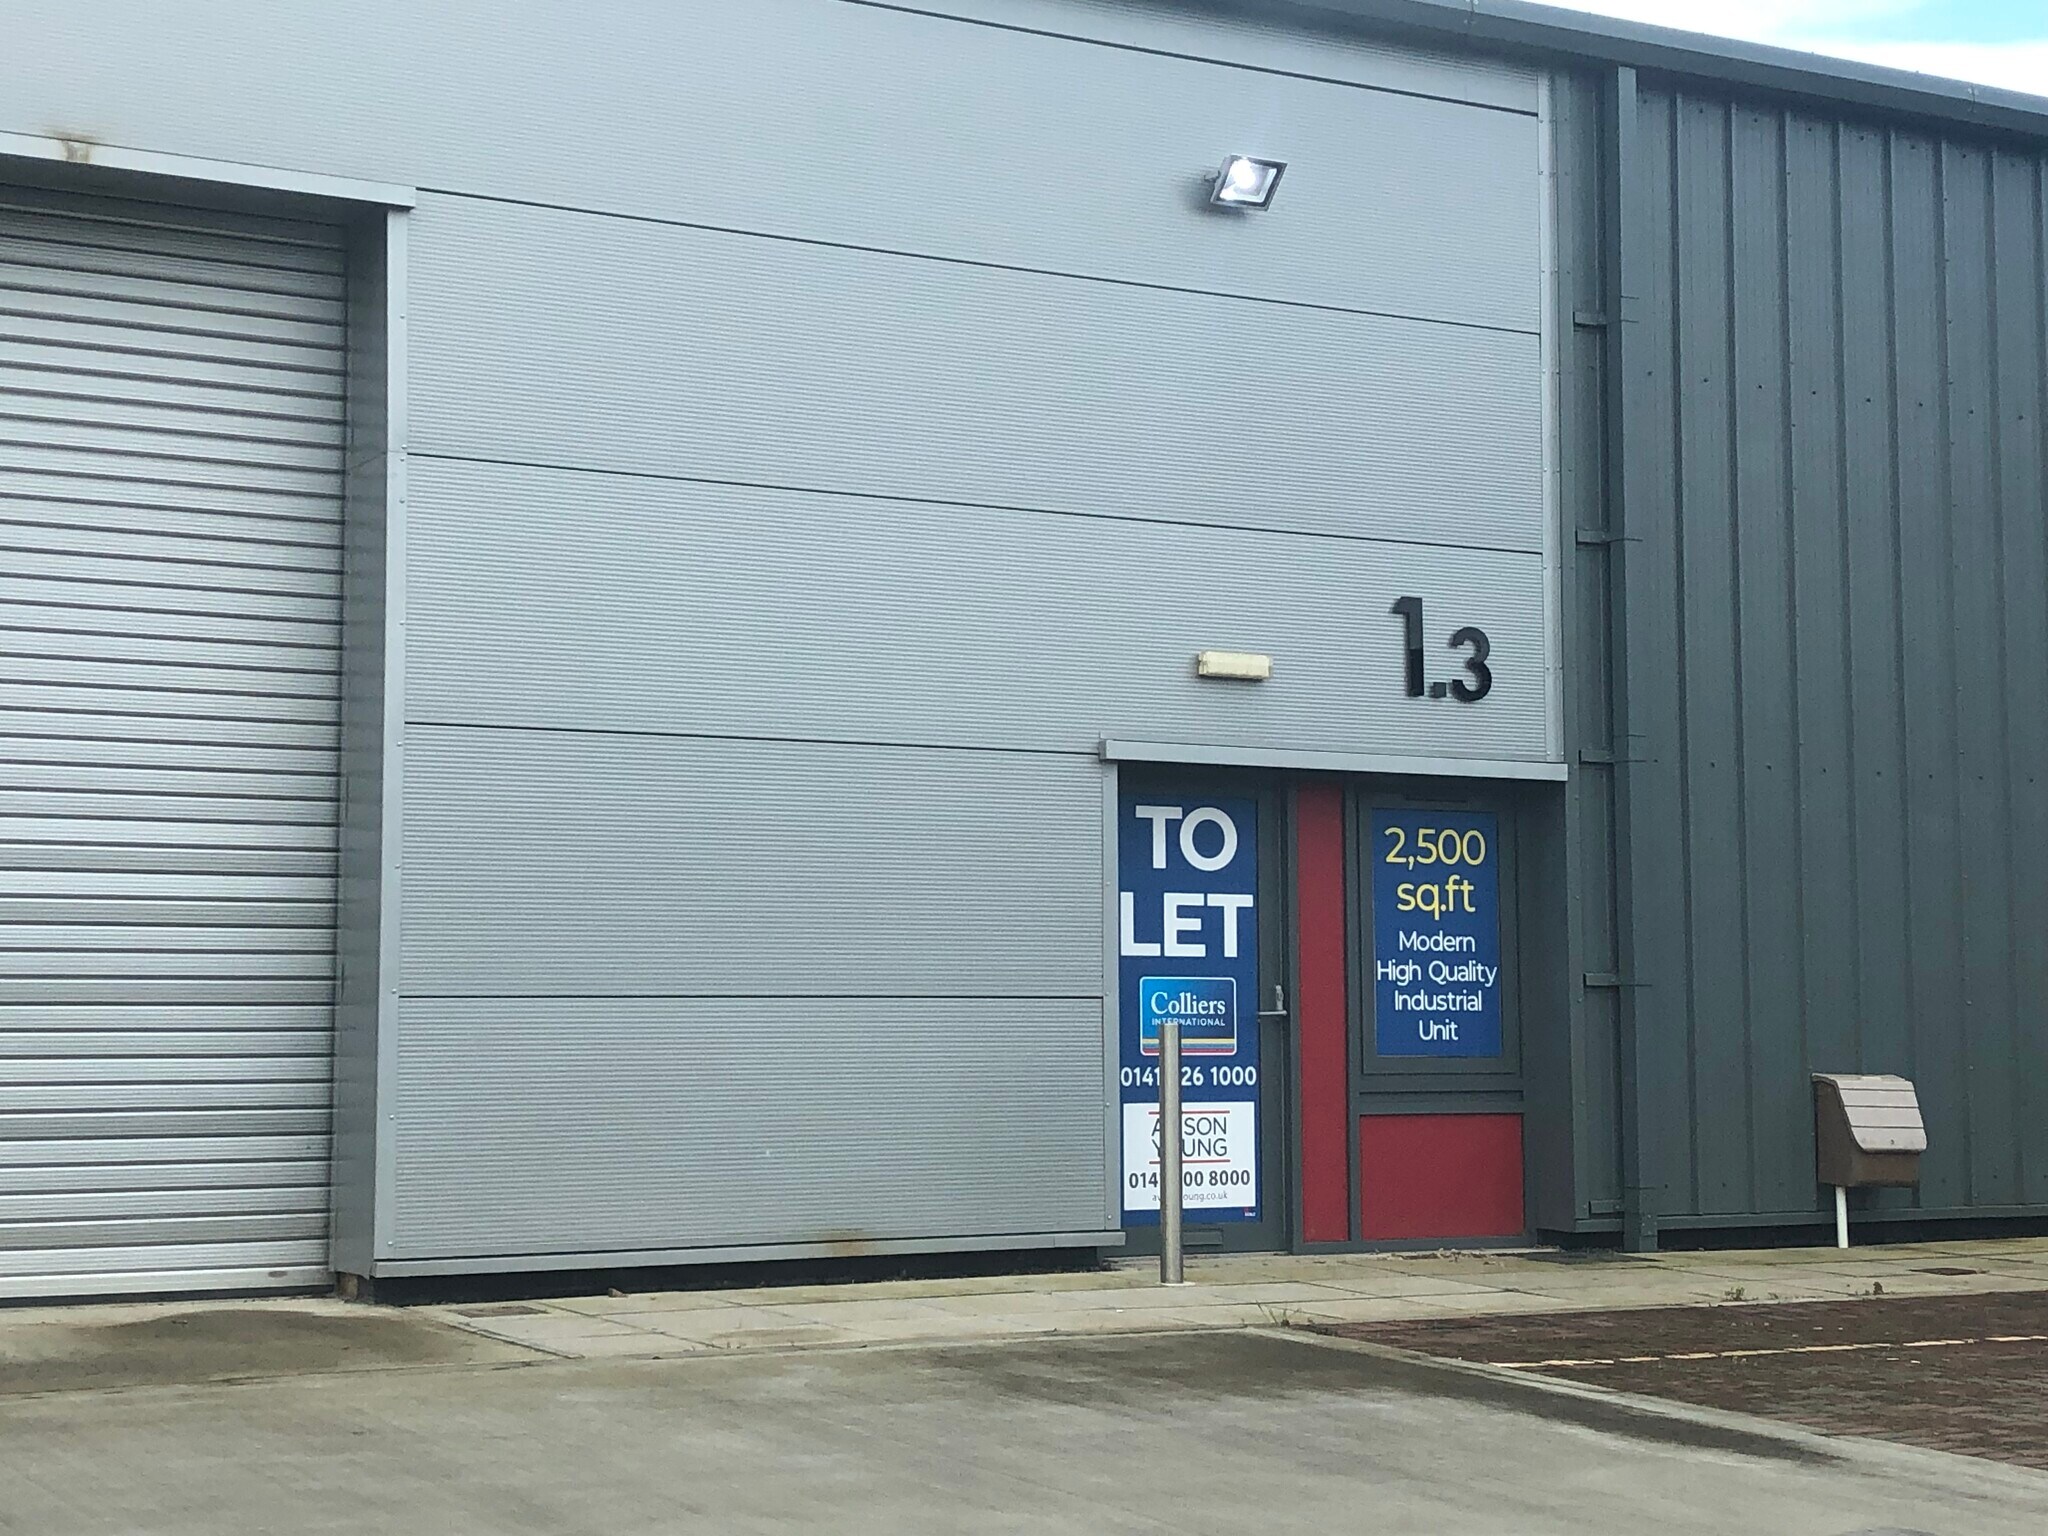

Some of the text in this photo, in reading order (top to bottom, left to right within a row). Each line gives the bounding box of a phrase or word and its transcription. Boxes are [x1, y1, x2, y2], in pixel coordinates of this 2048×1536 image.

[1388, 596, 1493, 703] 1.3
[1135, 805, 1238, 871] TO
[1384, 827, 1486, 870] 2,500
[1397, 874, 1476, 920] sq.ft
[1120, 891, 1254, 958] LET
[1399, 930, 1475, 952] Modern
[1377, 959, 1498, 987] High Quality
[1151, 991, 1226, 1015] Colliers
[1395, 989, 1482, 1011] Industrial
[1419, 1019, 1458, 1040] Unit
[1180, 1066, 1204, 1086] 26
[1210, 1066, 1257, 1086] 1000
[1151, 1138, 1227, 1157] YUNG
[1129, 1170, 1250, 1188] 014 00 8000
